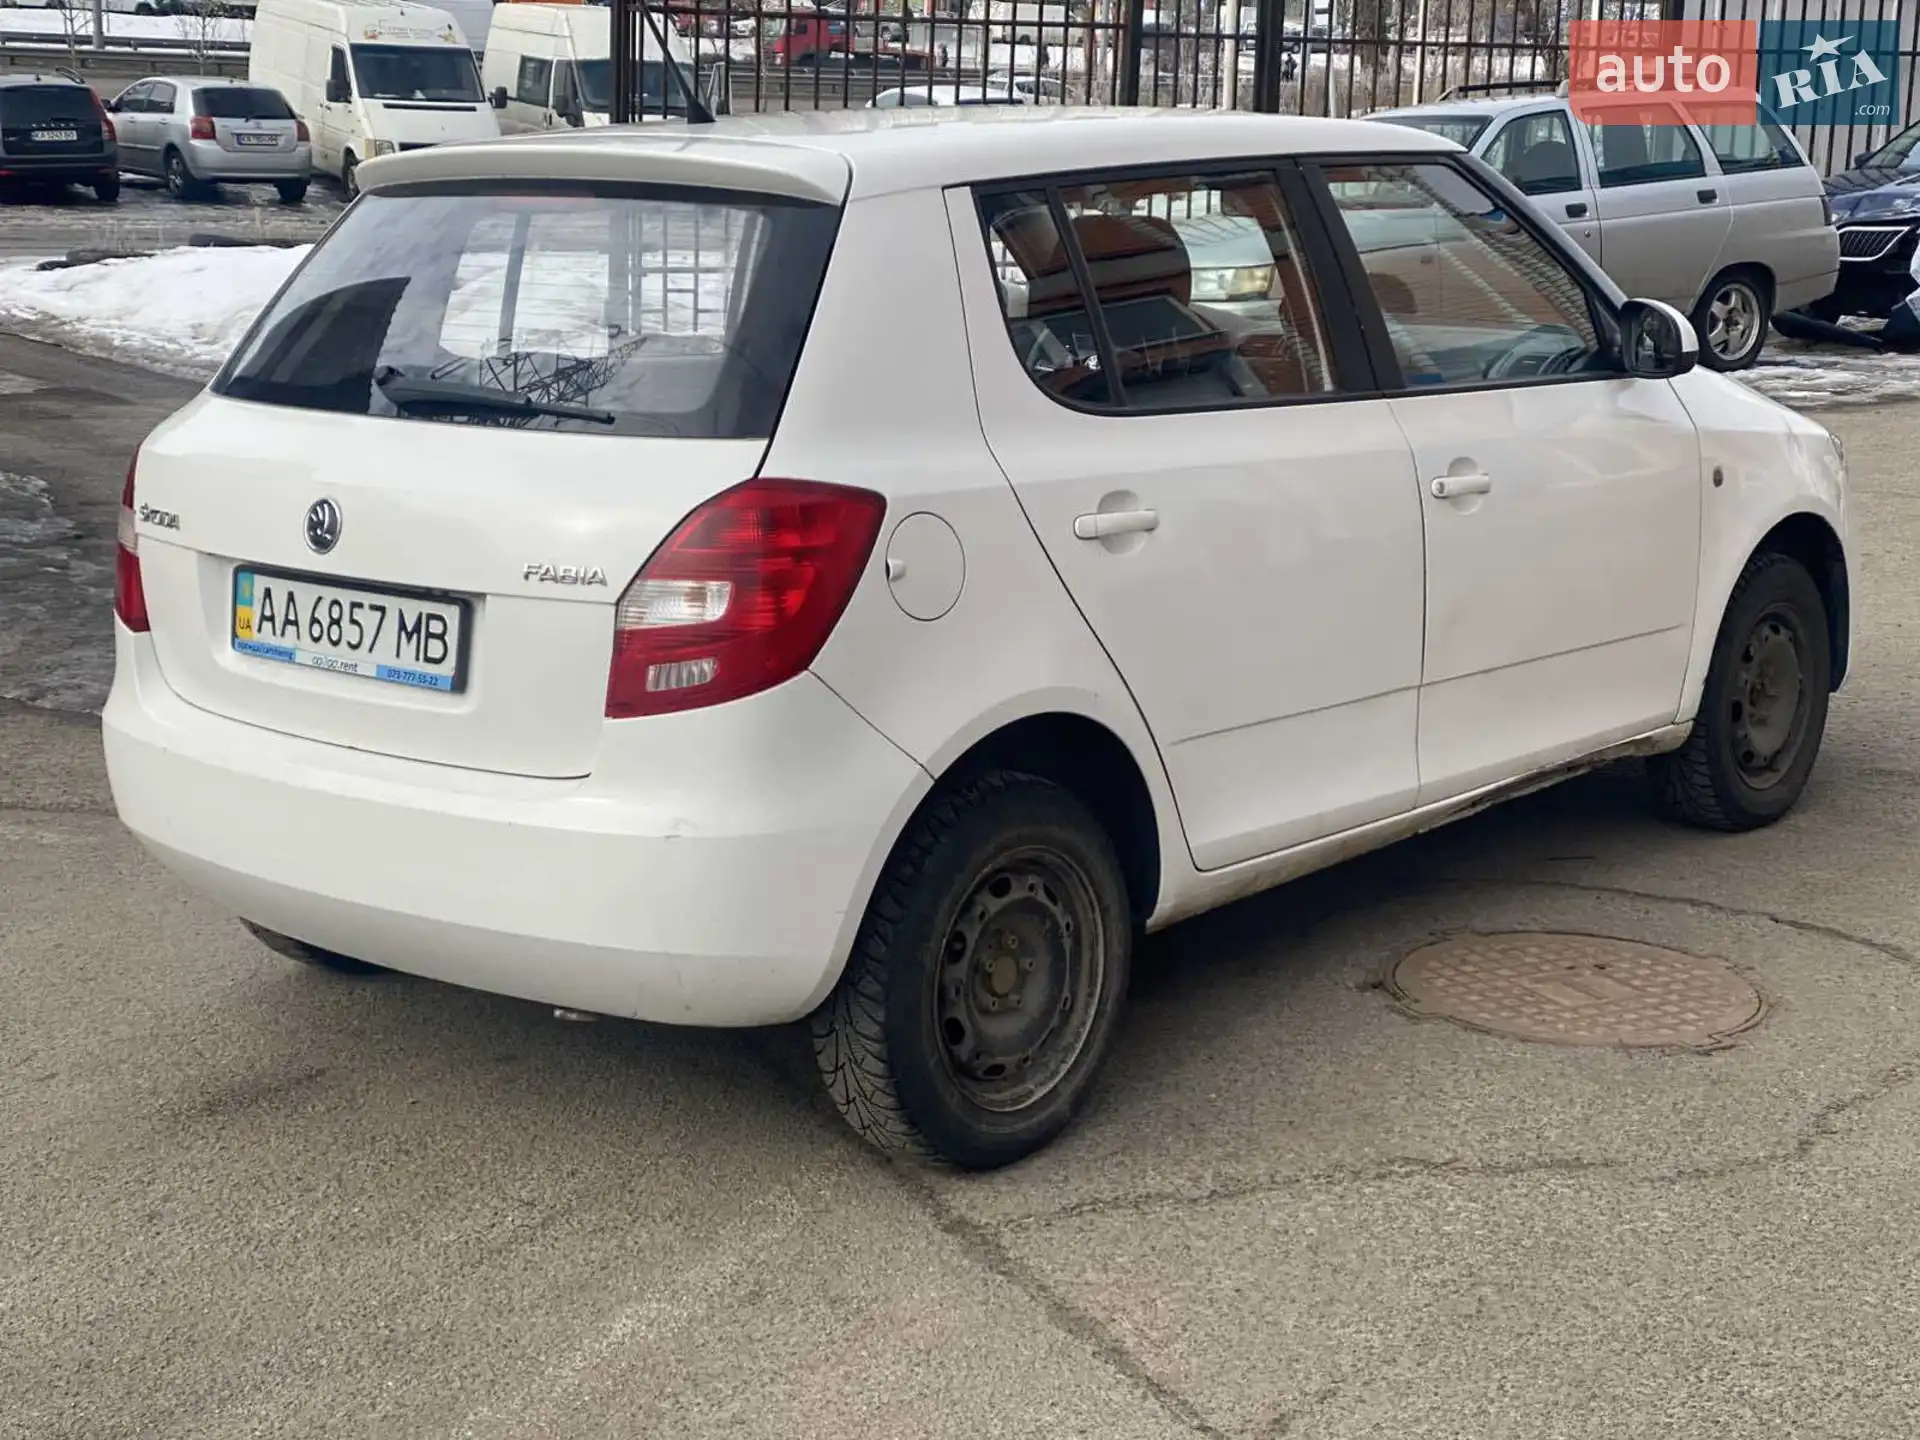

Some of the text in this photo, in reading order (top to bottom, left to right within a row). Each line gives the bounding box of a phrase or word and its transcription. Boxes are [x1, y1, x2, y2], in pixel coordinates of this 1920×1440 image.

[523, 563, 608, 587] FABIA
[238, 615, 252, 632] UA
[257, 587, 448, 664] AA 6857 MB
